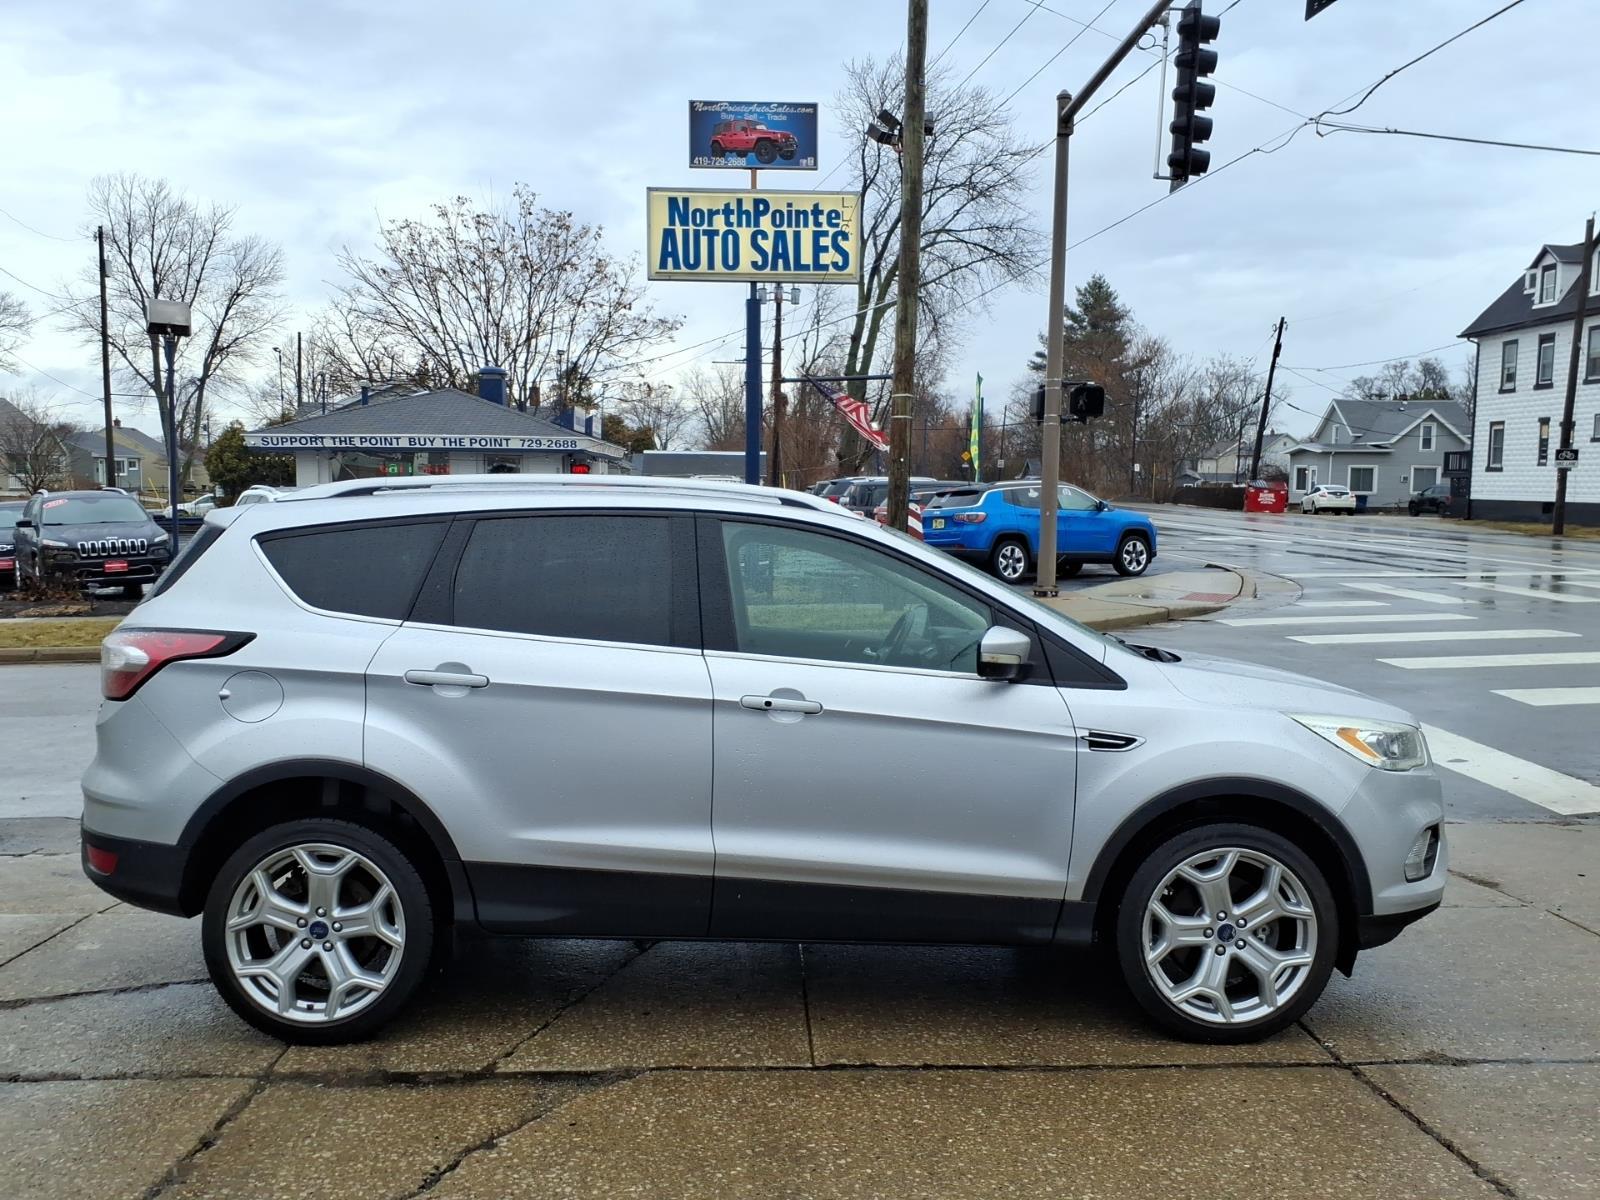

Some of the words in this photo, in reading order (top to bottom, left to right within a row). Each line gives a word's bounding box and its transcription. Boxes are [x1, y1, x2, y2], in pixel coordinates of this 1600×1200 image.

[693, 102, 815, 113] NorthPointeAutoSales.com
[720, 112, 735, 121] Buy
[766, 113, 787, 121] Trade
[693, 156, 746, 166] 419-729-2688
[667, 196, 842, 228] NorthPointe
[658, 228, 741, 271] AUTO
[750, 229, 850, 272] SALES
[261, 436, 326, 446] SUPPORT
[331, 436, 355, 446] THE
[359, 437, 401, 447] POINT
[408, 437, 435, 447] BUY
[440, 437, 466, 447] THE
[469, 438, 511, 448] POINT
[519, 438, 578, 449] 729-2688
